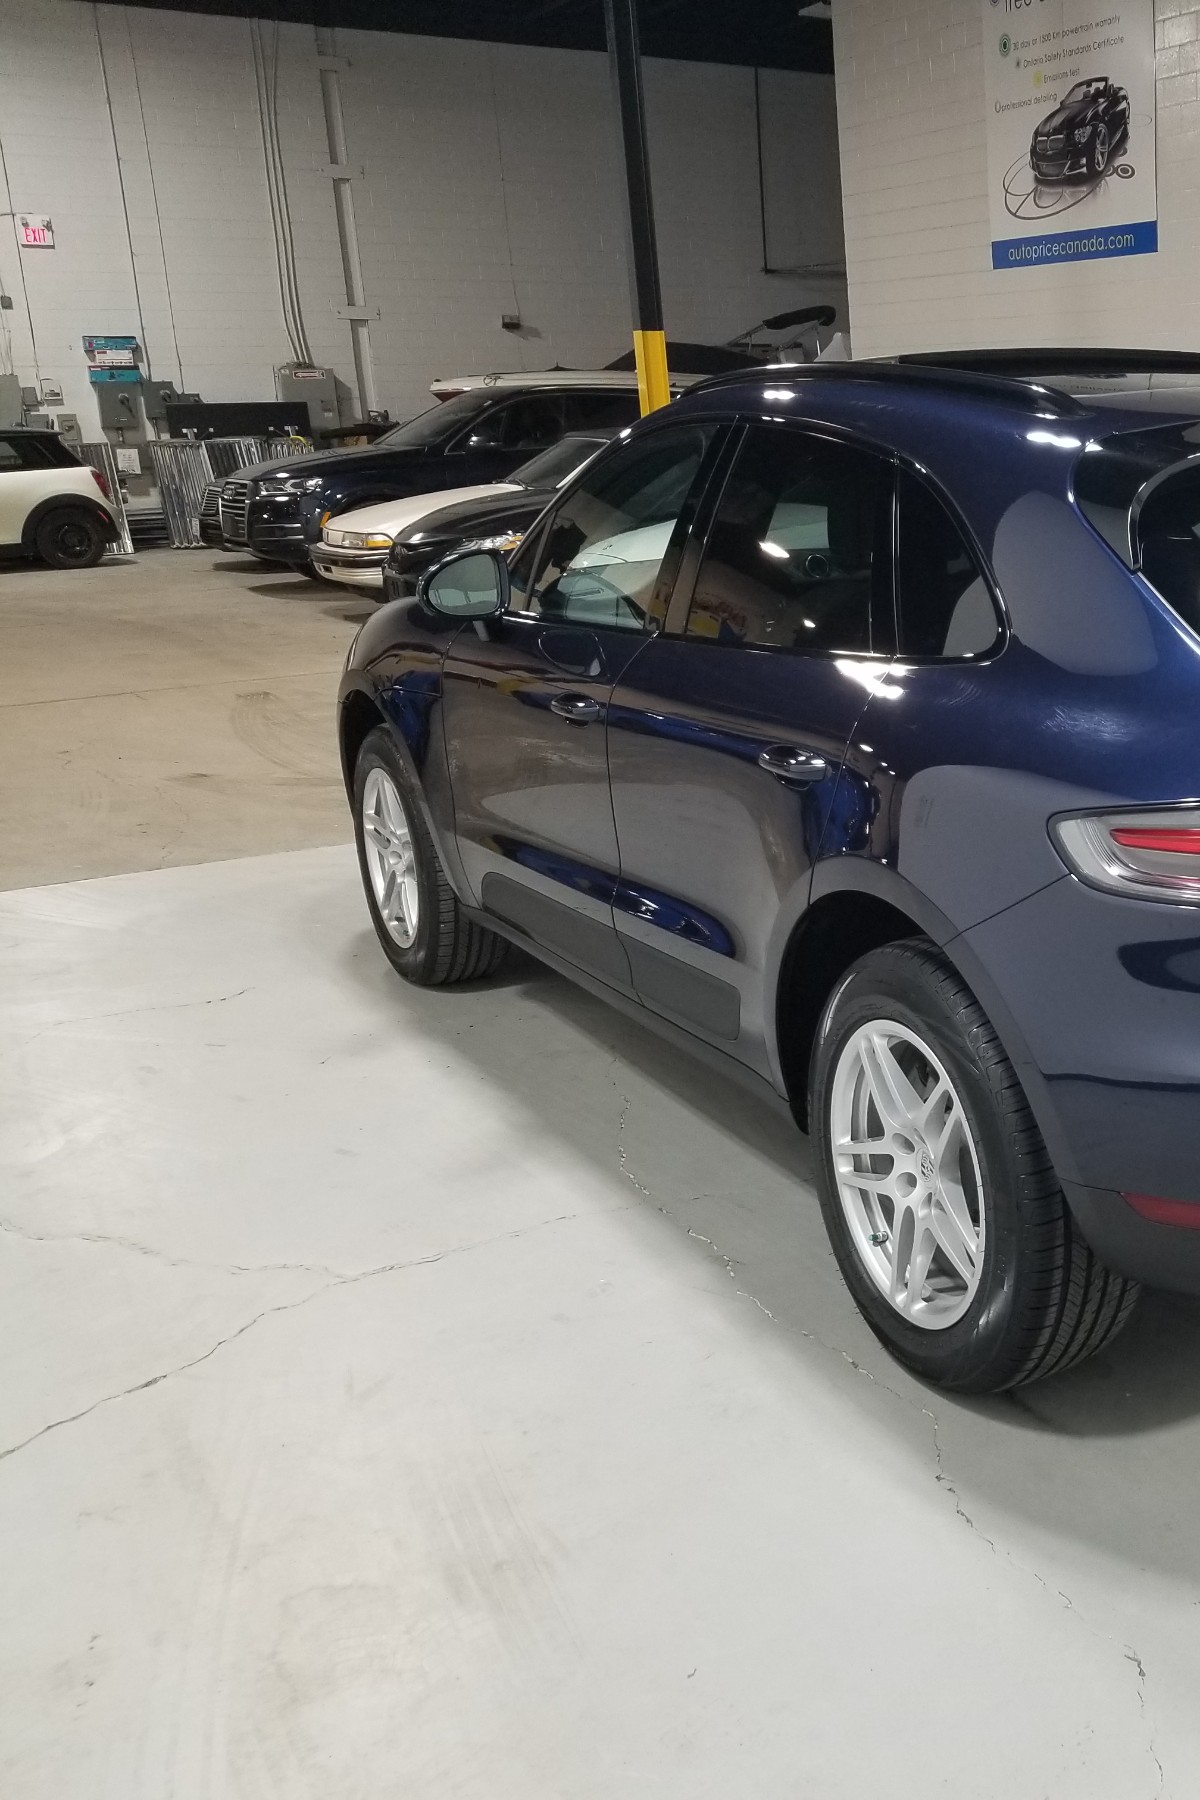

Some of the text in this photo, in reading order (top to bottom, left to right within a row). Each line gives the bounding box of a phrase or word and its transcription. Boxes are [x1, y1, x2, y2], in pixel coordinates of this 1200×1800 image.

[1020, 39, 1031, 50] day
[1061, 22, 1094, 38] powertrain
[1094, 14, 1120, 29] warranty
[1023, 35, 1125, 68] Ontario Safety Standards Certificate
[1033, 92, 1058, 106] detailing
[24, 227, 46, 243] EXIT
[1008, 233, 1135, 261] autopricecanada.com
